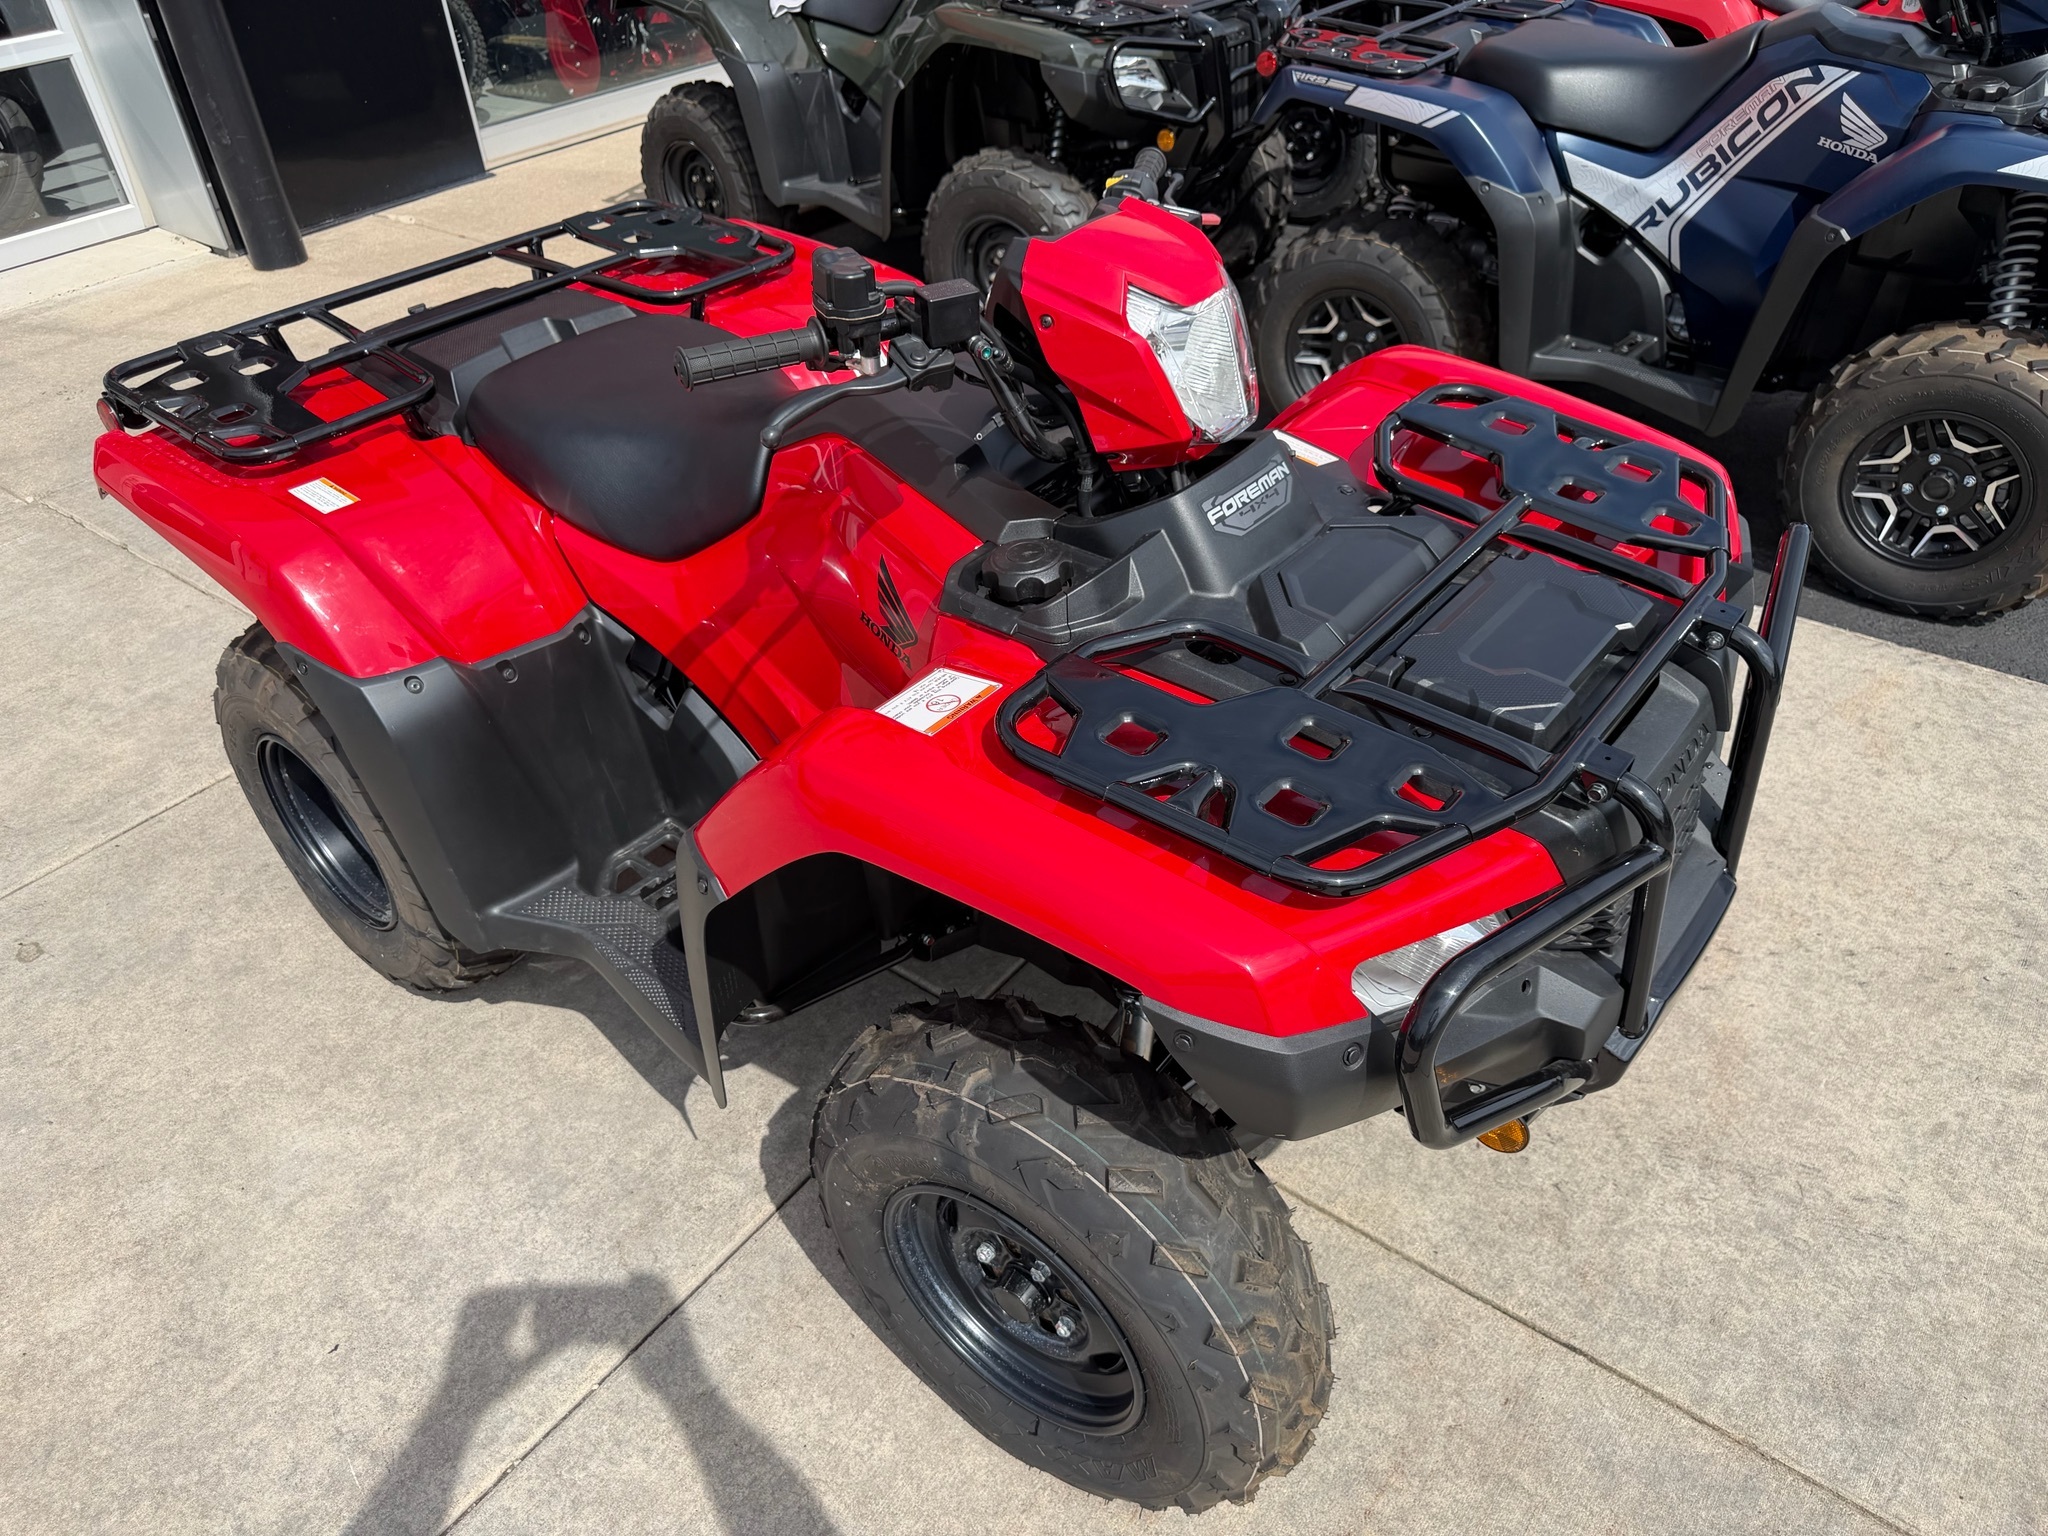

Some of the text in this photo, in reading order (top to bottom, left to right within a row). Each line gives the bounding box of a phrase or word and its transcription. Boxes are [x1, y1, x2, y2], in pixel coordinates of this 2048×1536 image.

[1631, 65, 1826, 232] RUBICON
[1696, 75, 1788, 159] FOREMAN
[1817, 135, 1879, 164] HONDA
[1206, 461, 1290, 526] FOREMAN
[860, 609, 913, 671] HONDA
[946, 697, 977, 720] WARNING
[1657, 722, 1712, 803] ONDA
